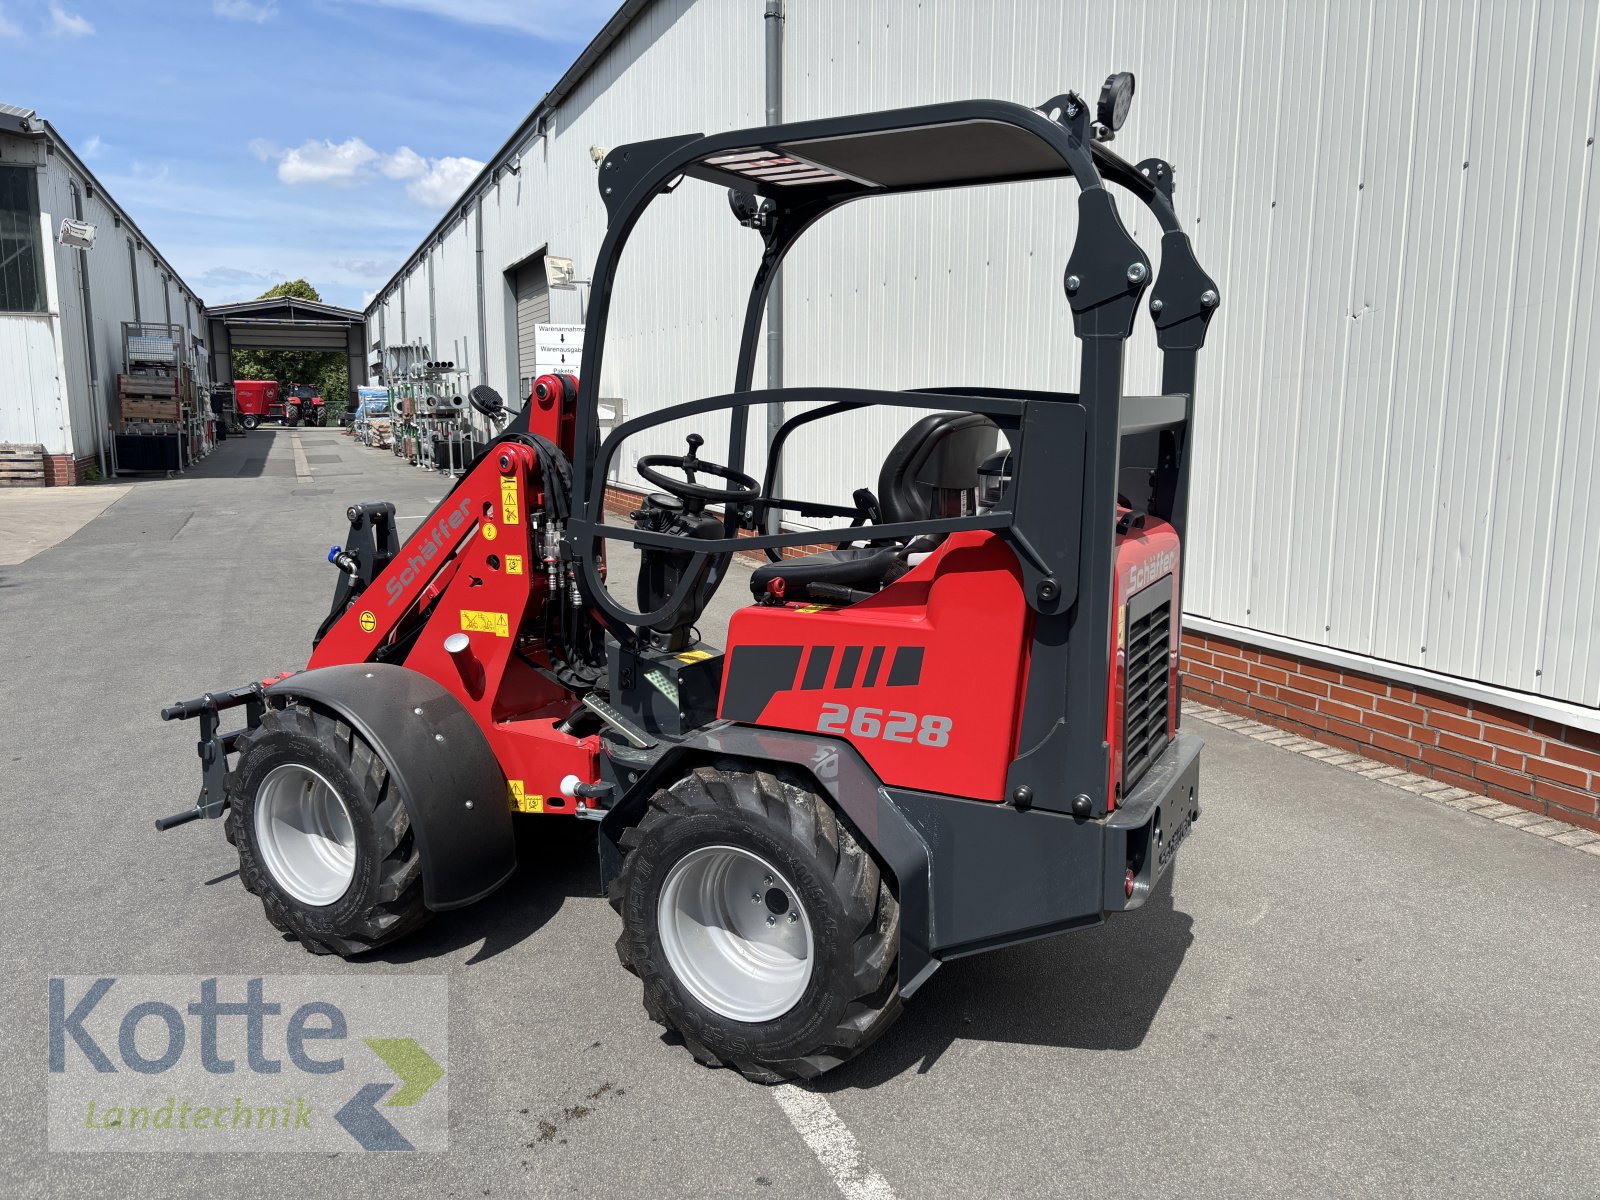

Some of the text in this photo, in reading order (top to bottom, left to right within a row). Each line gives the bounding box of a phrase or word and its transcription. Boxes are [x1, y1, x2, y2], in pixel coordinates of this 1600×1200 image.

[386, 498, 471, 607] Schäffer
[1126, 551, 1174, 596] Schäffer
[817, 702, 953, 748] 2628
